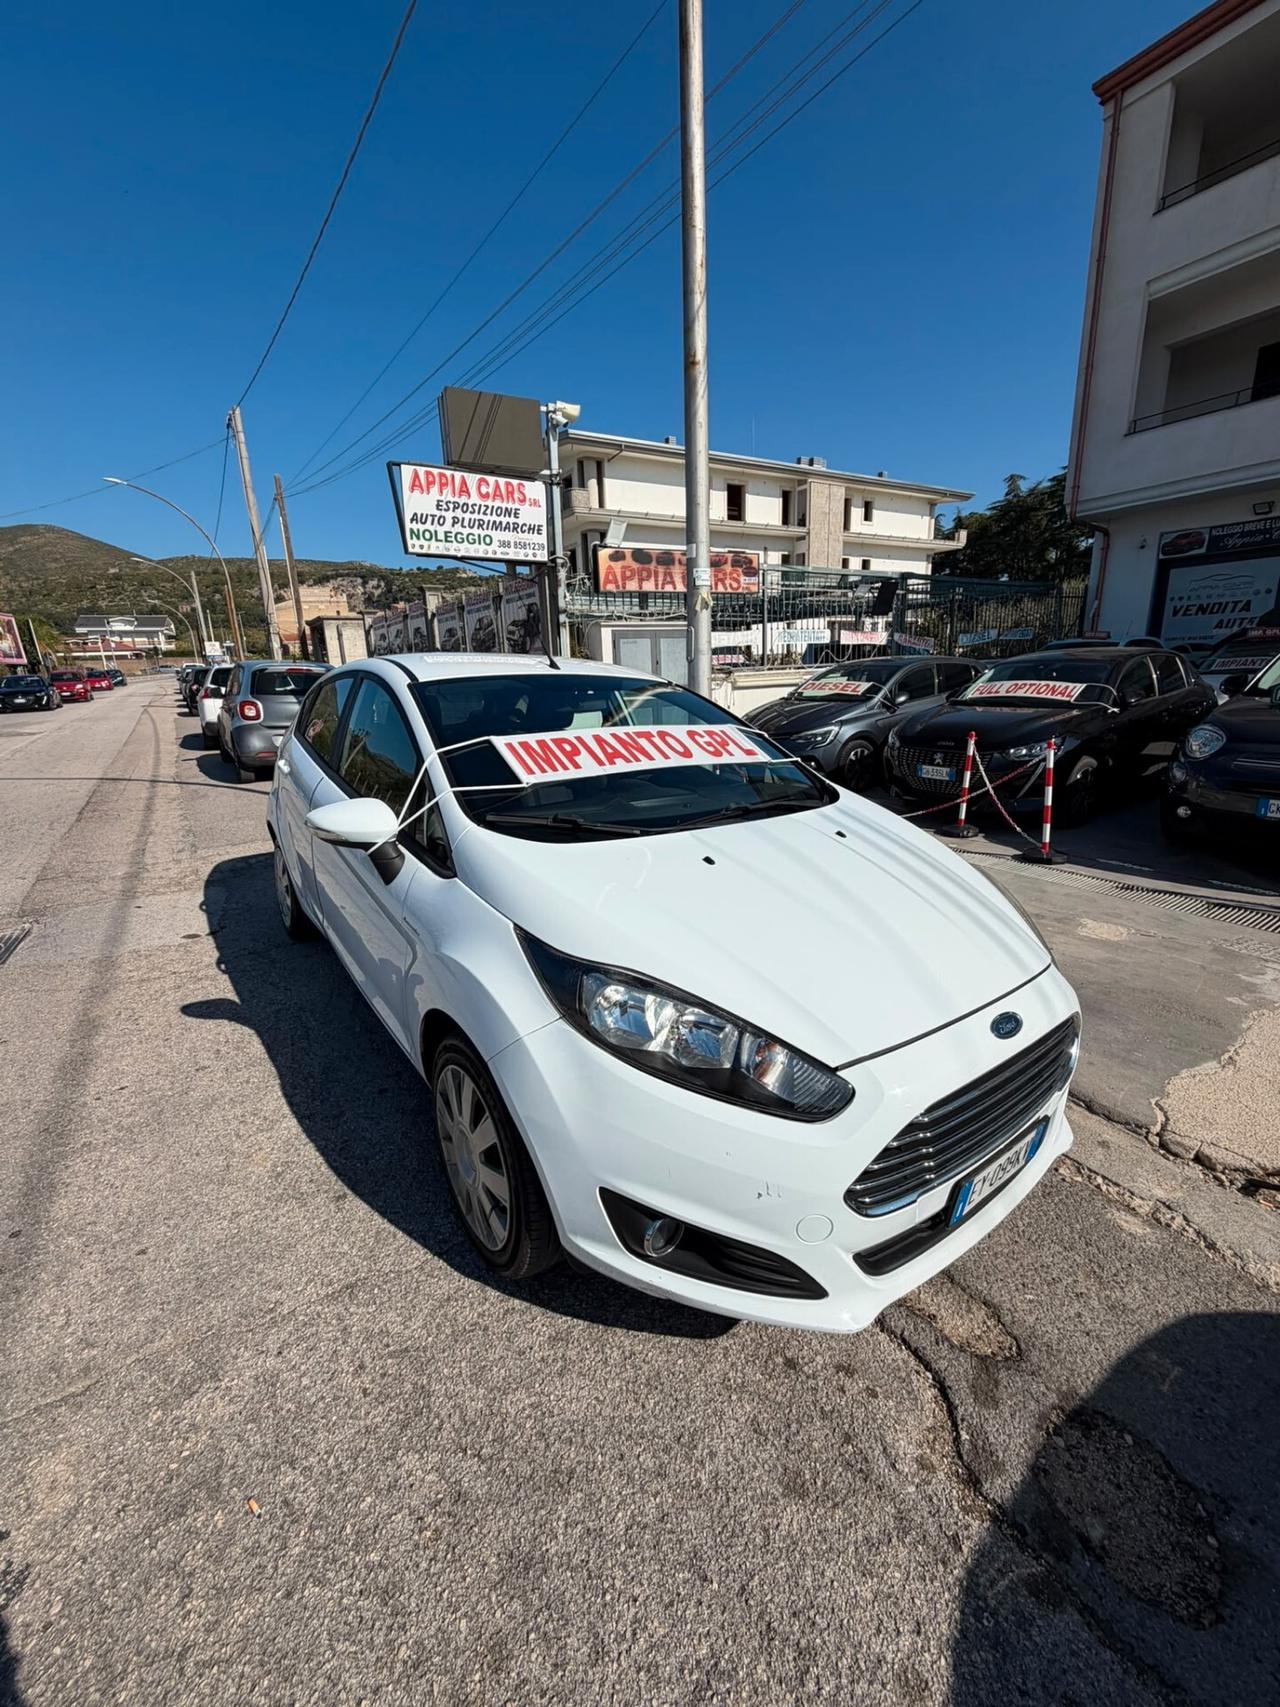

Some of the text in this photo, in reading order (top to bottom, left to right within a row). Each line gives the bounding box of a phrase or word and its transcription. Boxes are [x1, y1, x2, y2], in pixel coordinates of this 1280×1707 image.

[409, 469, 541, 508] APPIA CARS SRL
[436, 499, 520, 519] ESPOSIZIONE
[410, 512, 543, 535] AUTO PLURIMARCHE
[1212, 524, 1243, 536] NOLEGGIO
[409, 527, 493, 546] NOLEGGIO
[497, 539, 545, 551] 388 8581239
[602, 564, 677, 590] APPIA
[1171, 599, 1252, 617] VENDITA
[1215, 658, 1270, 669] IMPIANT
[801, 682, 862, 693] DIESEL
[973, 682, 1076, 698] FULL OPTIONAL
[504, 729, 758, 775] IMPIANTO GPL
